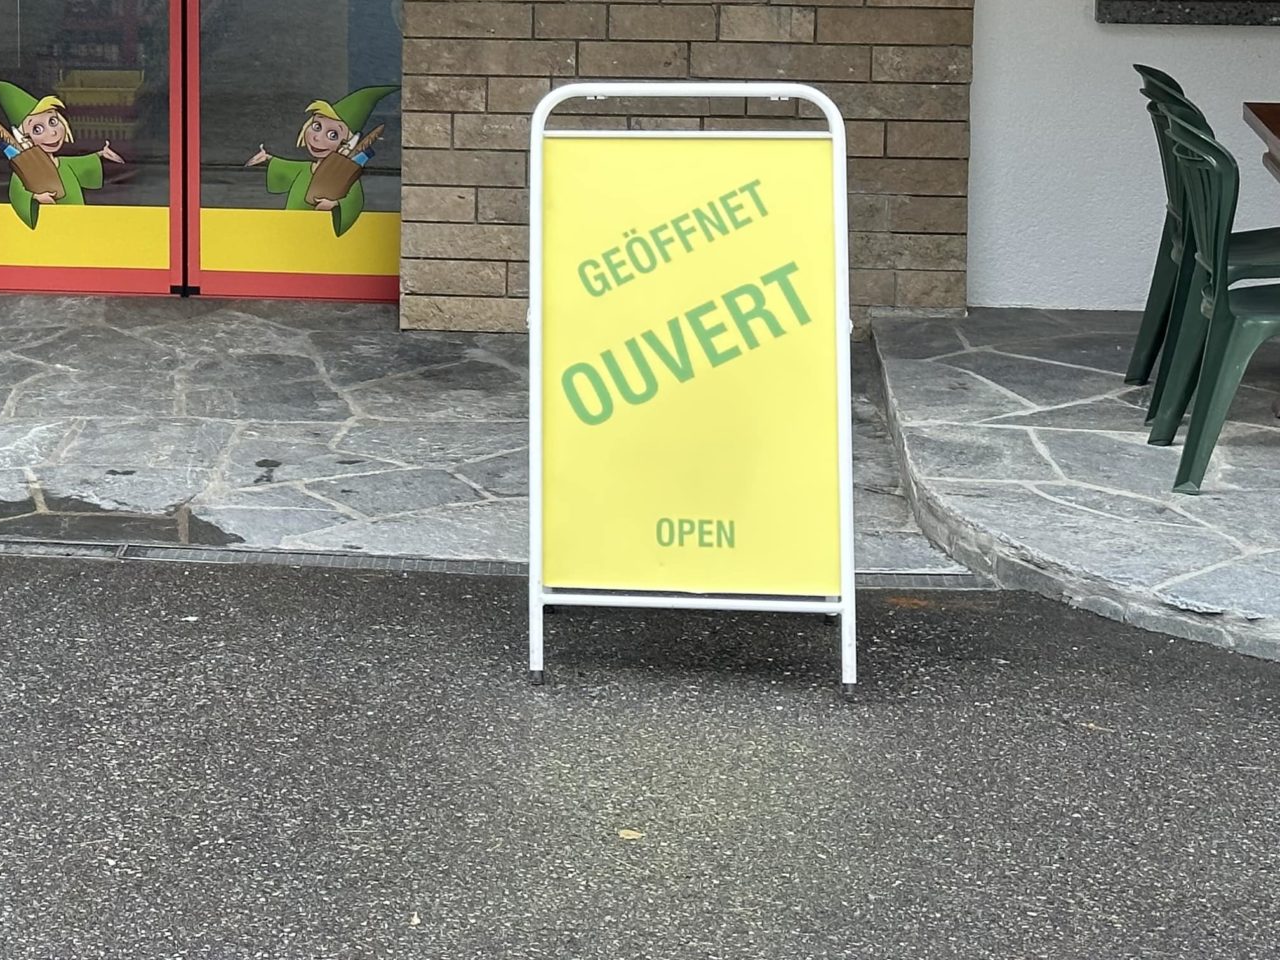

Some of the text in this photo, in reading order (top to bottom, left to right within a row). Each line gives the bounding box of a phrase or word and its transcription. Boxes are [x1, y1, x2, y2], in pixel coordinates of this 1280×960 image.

[577, 178, 770, 298] GEÖFFNET
[560, 261, 813, 426] OUVERT
[655, 517, 737, 549] OPEN
